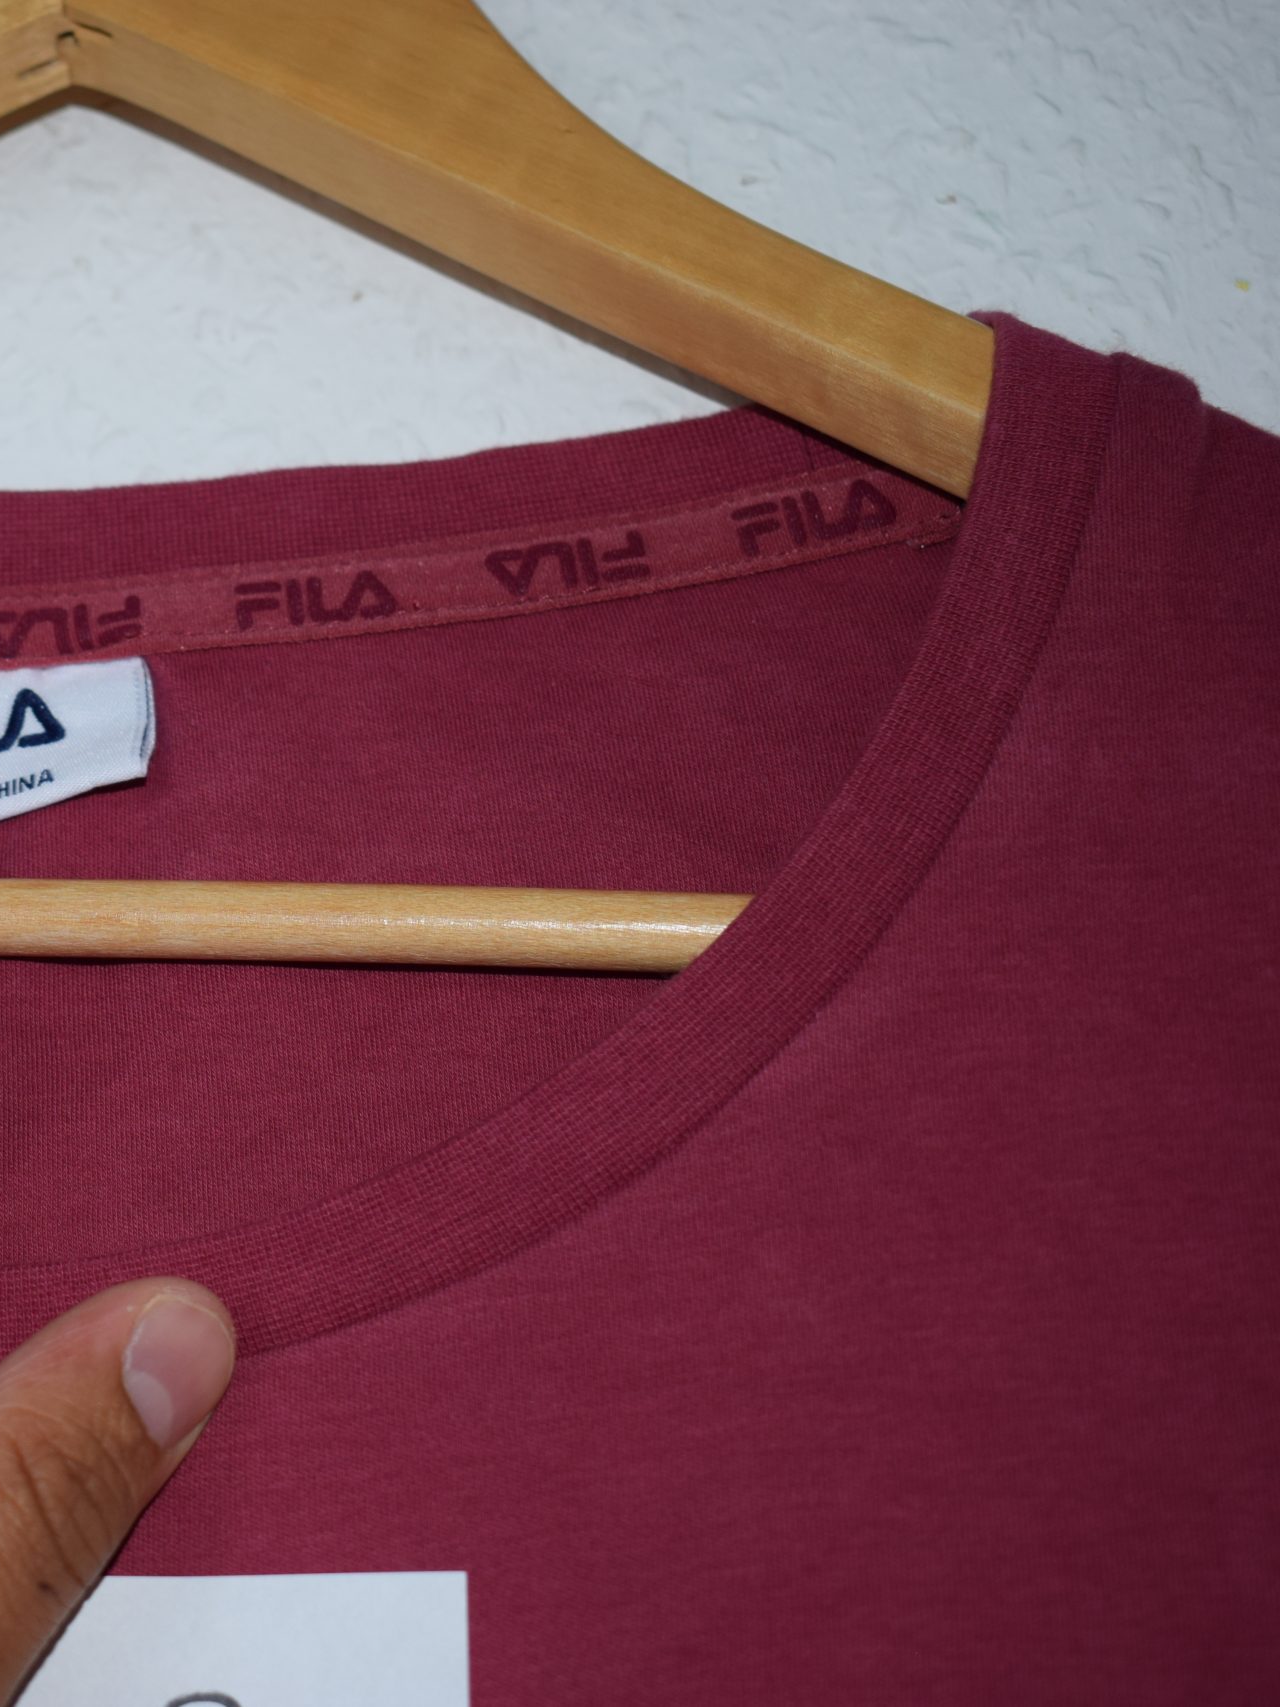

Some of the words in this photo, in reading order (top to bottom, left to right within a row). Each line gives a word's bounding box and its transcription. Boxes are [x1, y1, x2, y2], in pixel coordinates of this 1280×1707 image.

[729, 478, 897, 557] FILA
[484, 530, 651, 597] FILA
[234, 570, 399, 632] FILA
